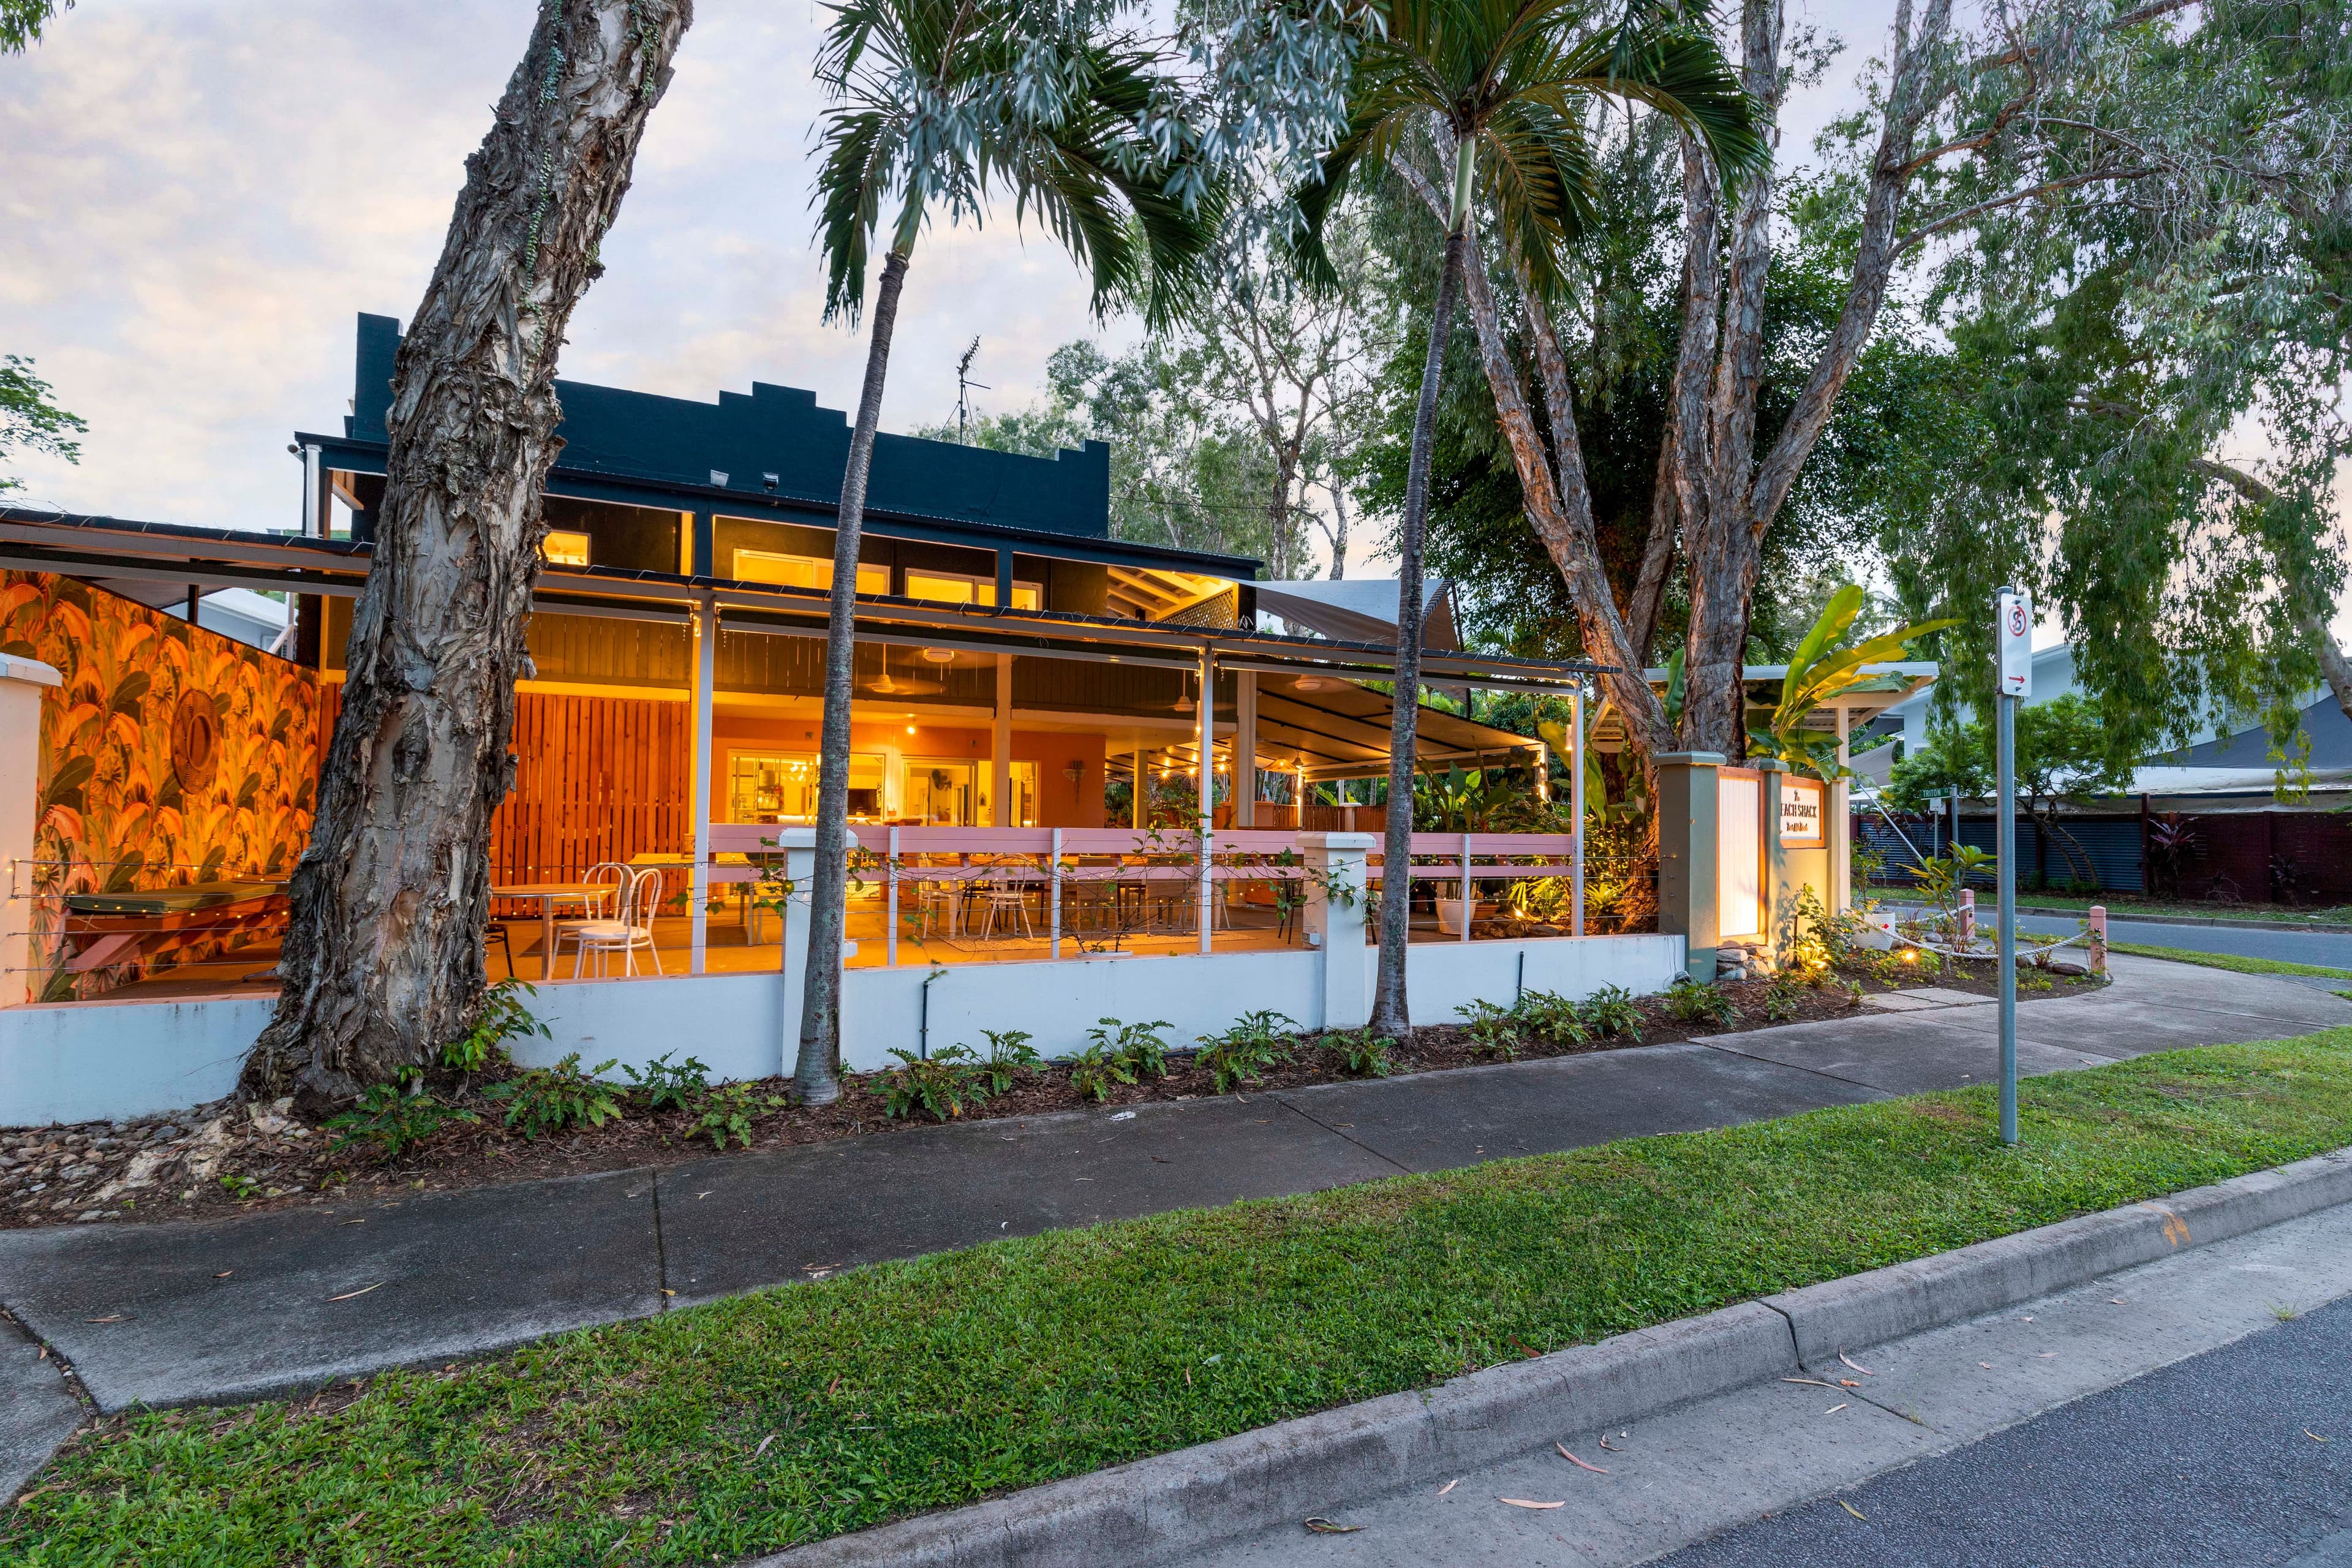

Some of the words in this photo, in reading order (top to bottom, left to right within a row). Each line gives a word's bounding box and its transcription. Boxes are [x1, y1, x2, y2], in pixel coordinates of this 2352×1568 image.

[1923, 788, 1941, 797] TRITON
[1780, 803, 1796, 816] EACH
[1798, 804, 1817, 818] SHACK
